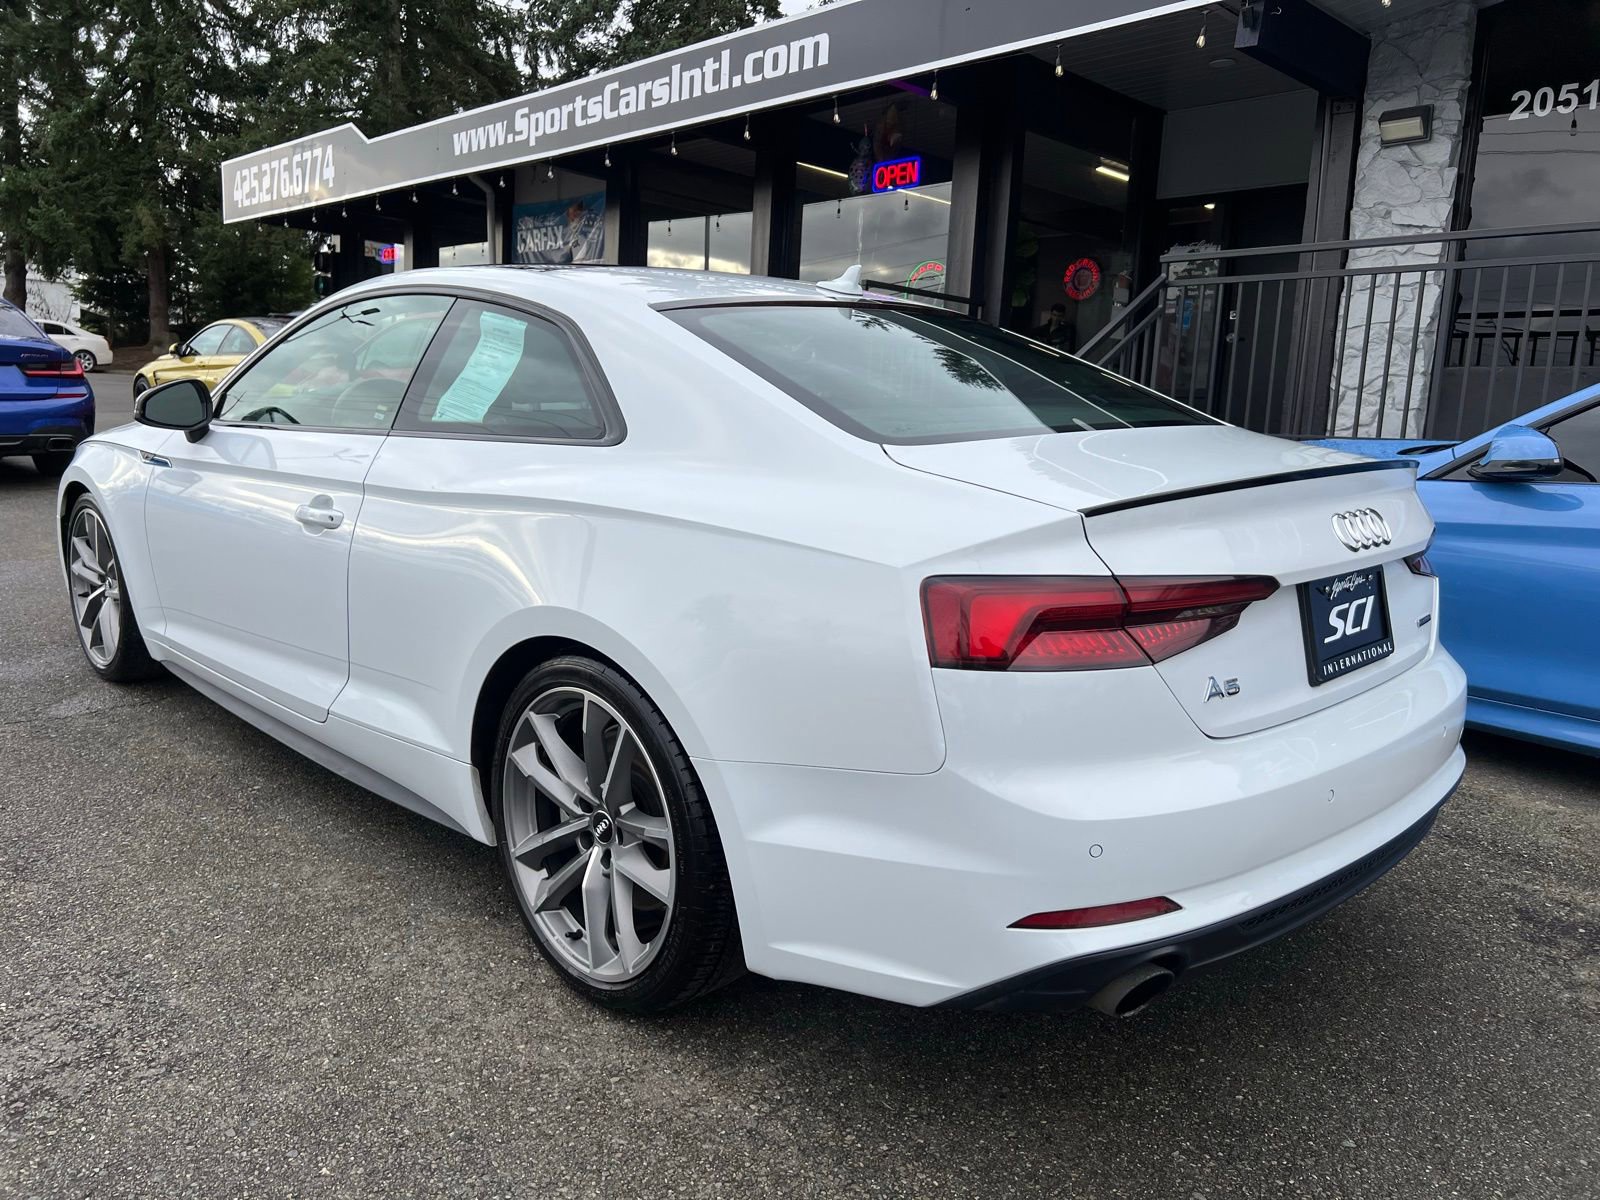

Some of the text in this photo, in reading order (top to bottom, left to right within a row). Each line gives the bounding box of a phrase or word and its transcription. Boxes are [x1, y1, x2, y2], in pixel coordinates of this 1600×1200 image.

[452, 32, 830, 156] www.SportsCarsIntl.com
[1508, 78, 1600, 121] 2051
[233, 143, 335, 208] 425.276.6774
[875, 161, 918, 189] OPEN
[517, 225, 564, 253] CARFAX
[911, 262, 944, 284] HAPP
[1324, 595, 1375, 644] SCI
[1323, 642, 1392, 676] INTERNATIONAL
[1203, 676, 1240, 703] A5
